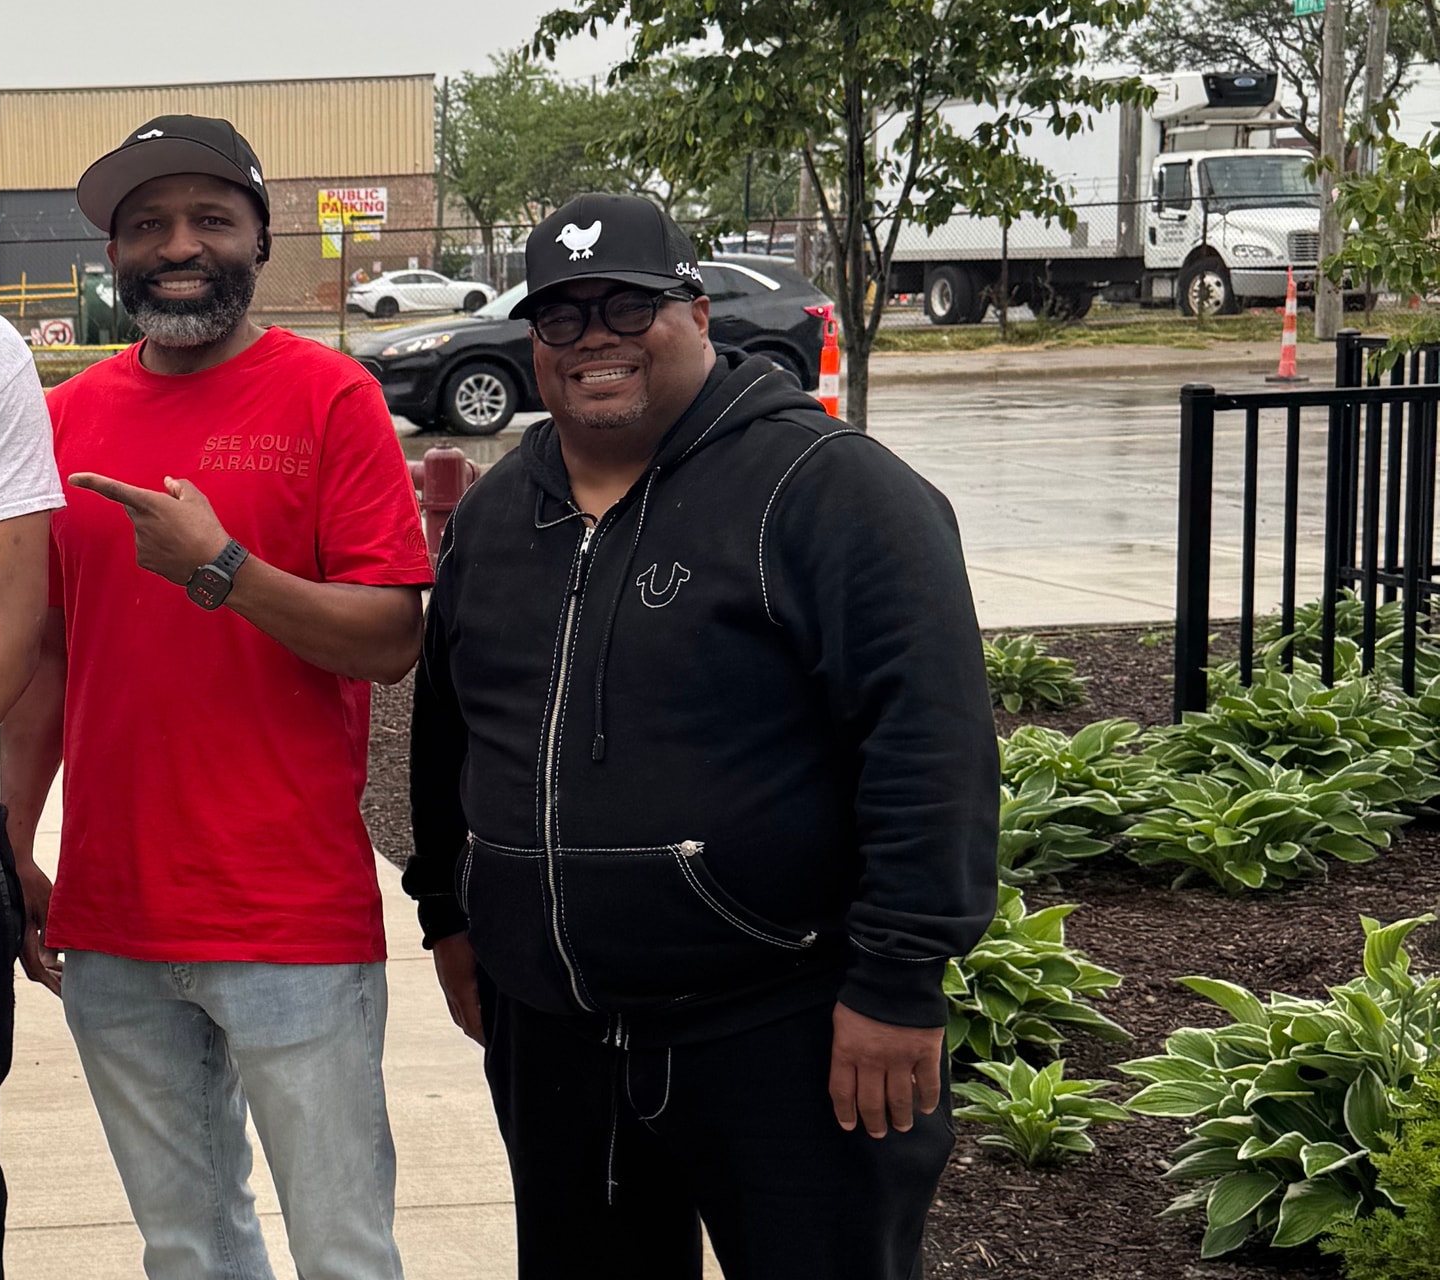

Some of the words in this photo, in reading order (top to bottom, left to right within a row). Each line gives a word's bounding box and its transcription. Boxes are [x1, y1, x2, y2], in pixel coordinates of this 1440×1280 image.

[327, 189, 379, 201] PUBLIC
[321, 201, 385, 214] PARKING
[204, 435, 242, 452] SEE
[248, 434, 290, 452] YOU
[295, 437, 314, 456] IN
[199, 454, 311, 478] PARADISE
